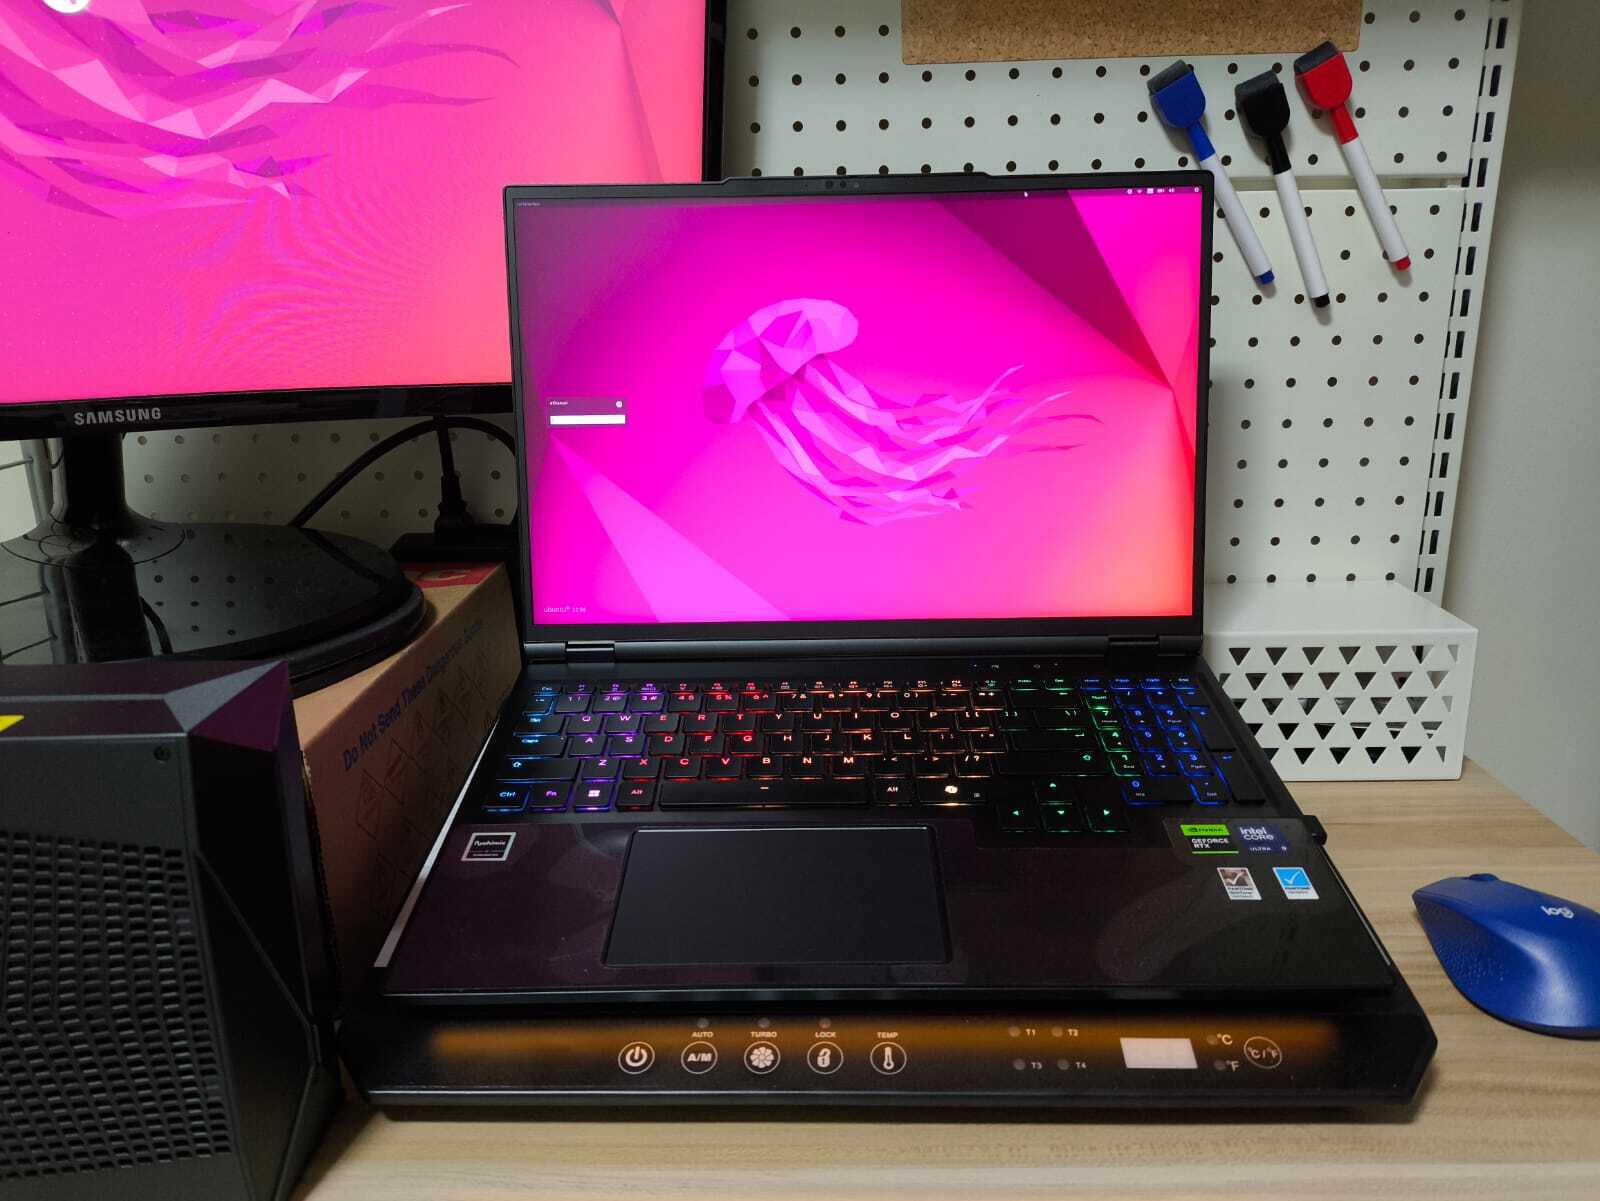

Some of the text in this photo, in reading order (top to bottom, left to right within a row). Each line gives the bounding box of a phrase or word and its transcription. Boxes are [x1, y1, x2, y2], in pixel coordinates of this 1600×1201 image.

[73, 407, 162, 426] SAMSUNG
[342, 746, 359, 772] Do
[1239, 826, 1268, 835] intel
[1025, 1029, 1036, 1037] T1
[1067, 1029, 1079, 1037] T2
[687, 1052, 712, 1063] A/M
[1031, 1061, 1042, 1069] T3
[1075, 1061, 1087, 1069] T4
